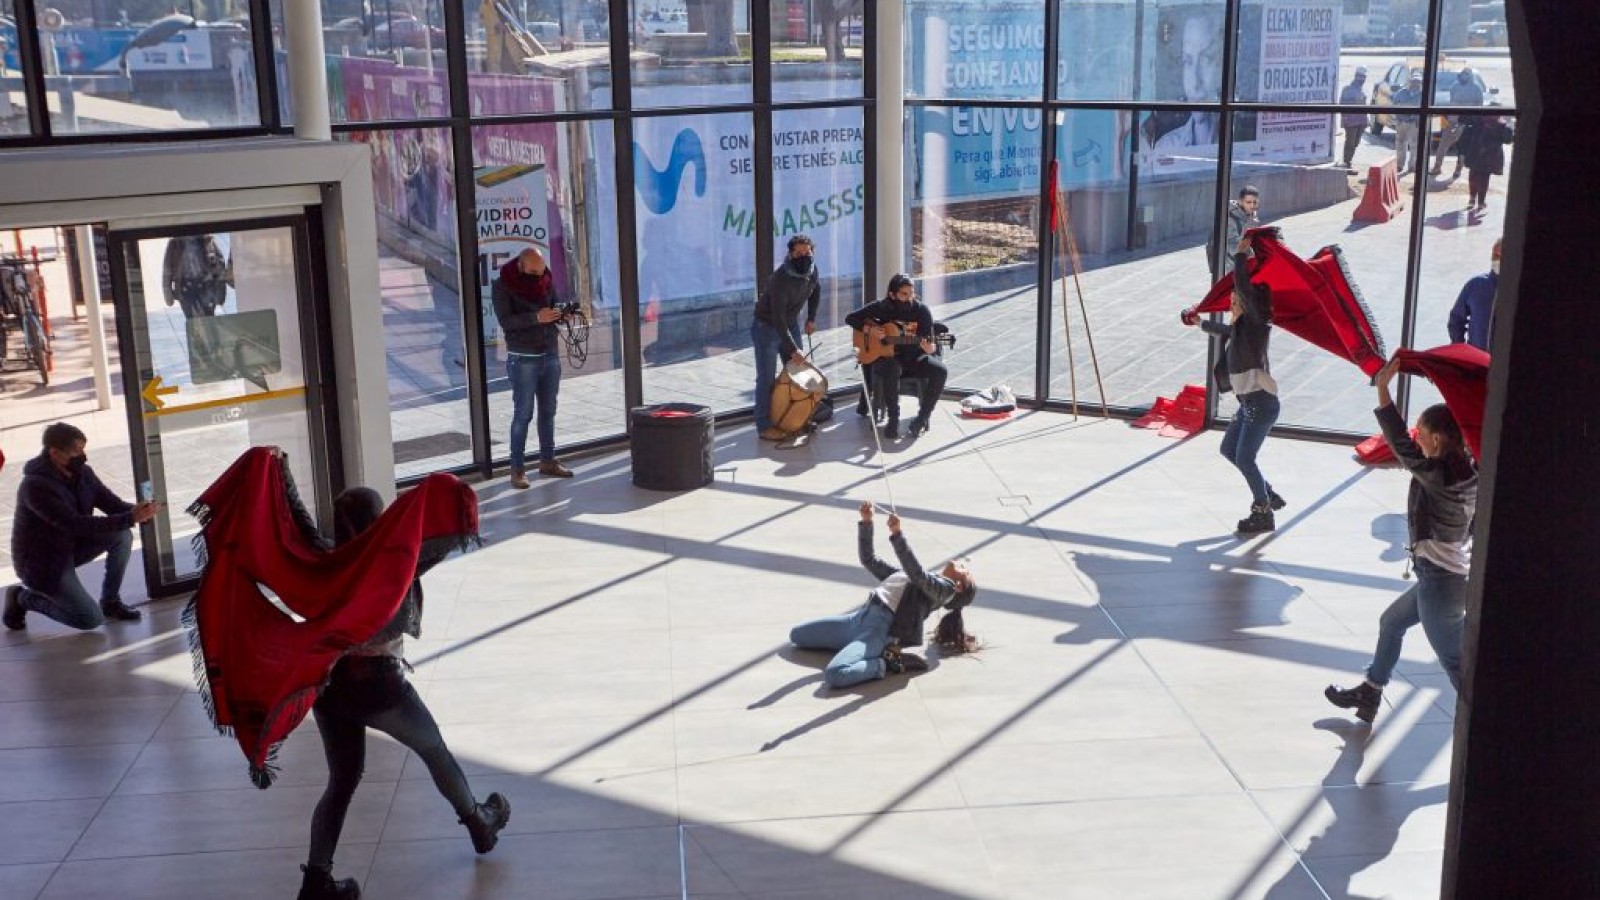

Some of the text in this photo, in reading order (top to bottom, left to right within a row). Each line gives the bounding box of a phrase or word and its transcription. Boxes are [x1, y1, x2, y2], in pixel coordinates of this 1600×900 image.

[1266, 8, 1332, 33] ELENA ROGER
[949, 24, 1044, 51] SEGUIMO
[943, 60, 1068, 88] CONFIANO
[1263, 66, 1329, 90] ORQUESTA
[952, 100, 1042, 135] EN VO
[720, 127, 864, 150] CON VISTAR PREPA
[730, 147, 864, 175] SIERE TENÉS ALG
[955, 150, 981, 164] Para
[480, 223, 546, 240] MPLADO
